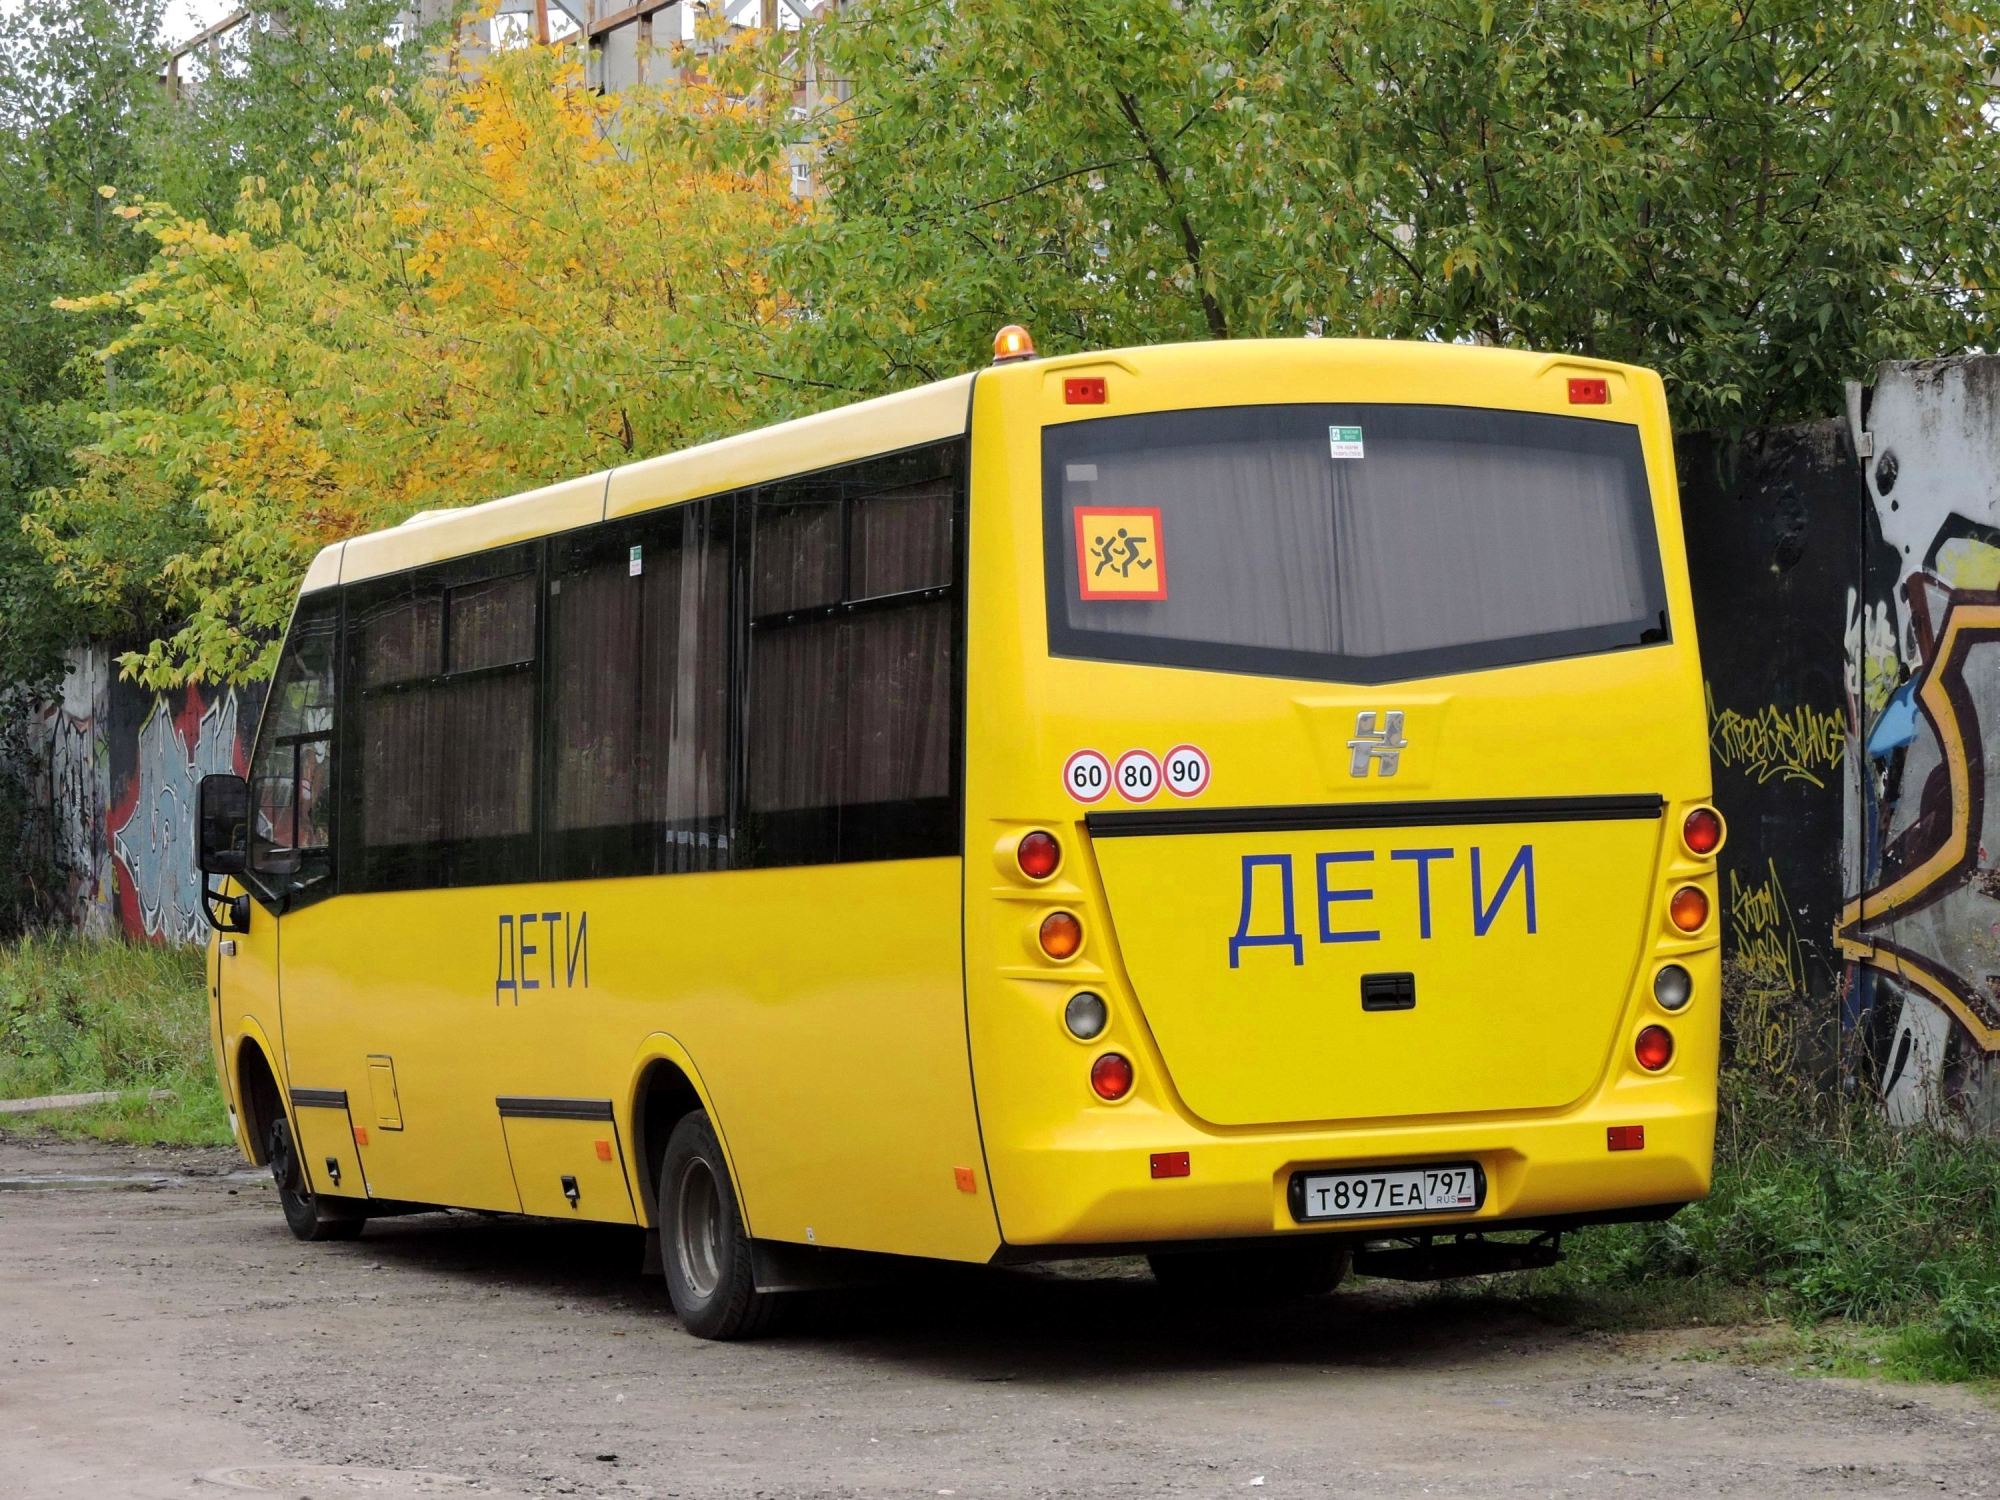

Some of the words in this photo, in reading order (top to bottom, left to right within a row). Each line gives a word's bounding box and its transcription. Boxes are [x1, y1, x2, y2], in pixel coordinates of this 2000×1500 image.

[1073, 765, 1102, 788] 60
[1124, 765, 1152, 787] 80
[1172, 760, 1200, 782] 90
[1229, 845, 1537, 969] ДЕТИ
[496, 911, 589, 1007] ДЕТИ
[1427, 1172, 1467, 1196] 797
[1436, 1195, 1457, 1204] RUS
